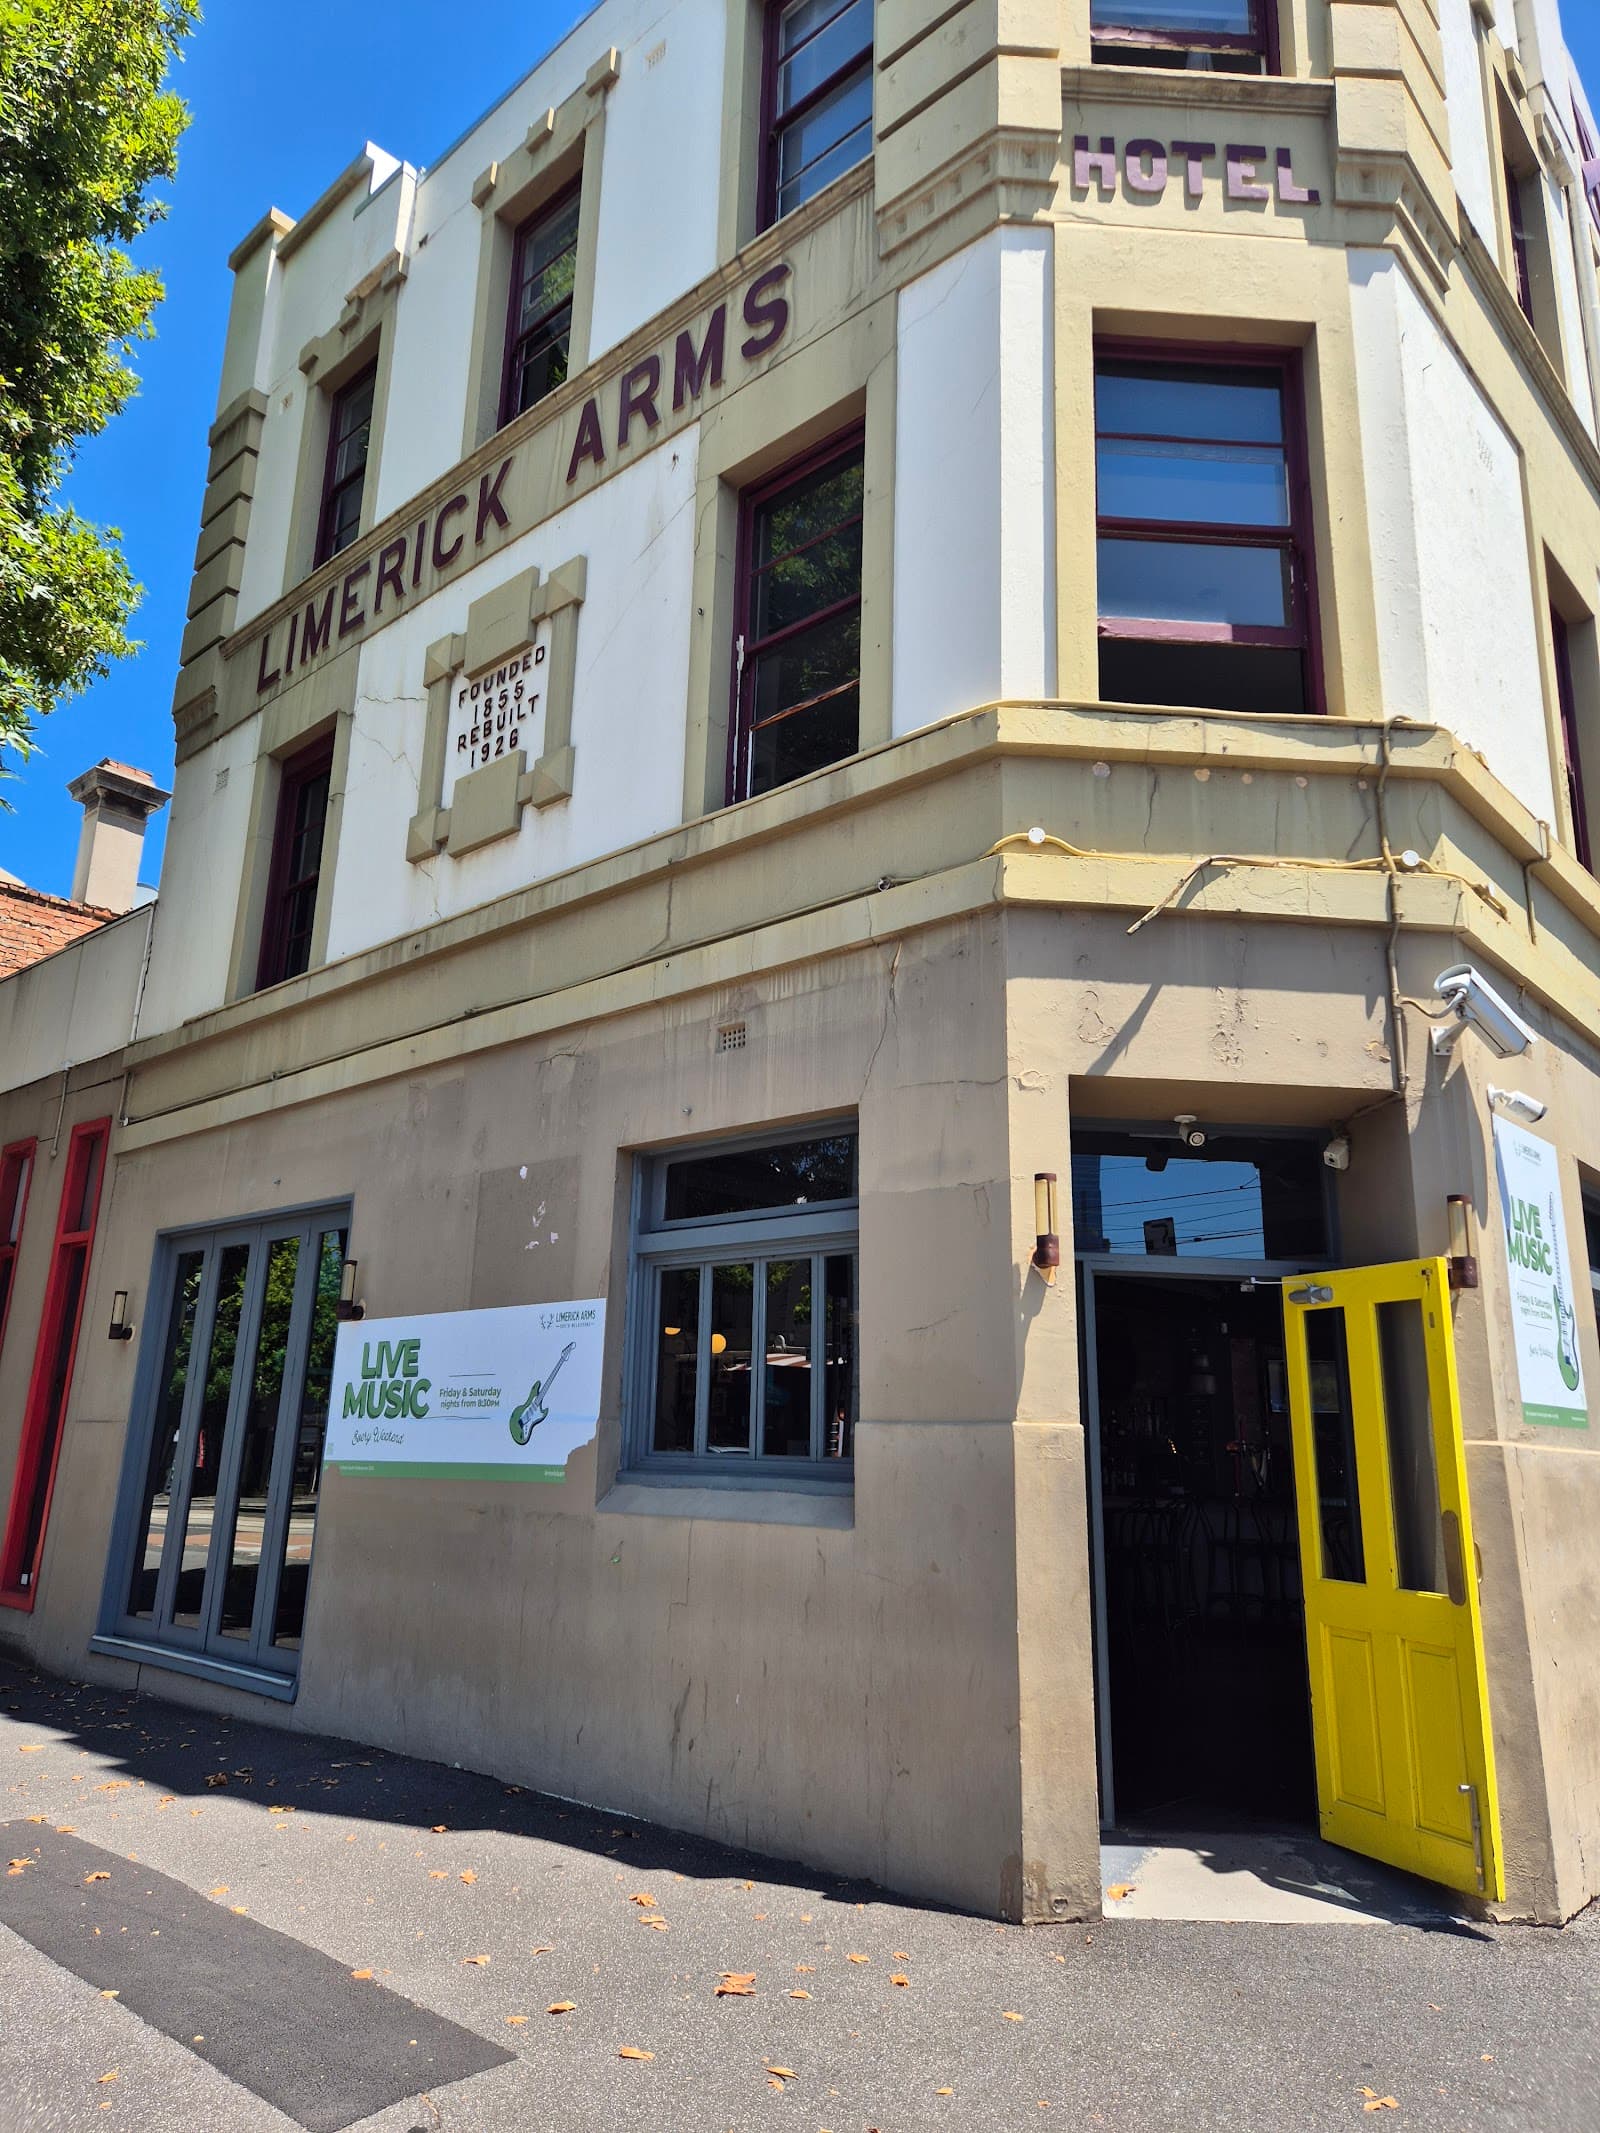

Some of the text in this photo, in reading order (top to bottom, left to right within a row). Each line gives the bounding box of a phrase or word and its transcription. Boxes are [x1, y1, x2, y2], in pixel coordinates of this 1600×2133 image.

[1073, 135, 1320, 206] HOTEL
[257, 263, 791, 694] LIMERICK ARMS
[458, 645, 545, 708] FOUNDED
[457, 694, 539, 753] REBUILT
[474, 679, 524, 724] 1855
[470, 728, 518, 768] 1926
[1510, 1194, 1543, 1240] LIVE
[1508, 1232, 1553, 1276] MUSIC
[360, 1338, 421, 1379] LIVE
[342, 1378, 431, 1419] MUSIC
[440, 1387, 461, 1399] Friday
[469, 1386, 502, 1398] Saturday
[440, 1399, 460, 1410] nights
[461, 1399, 477, 1408] from
